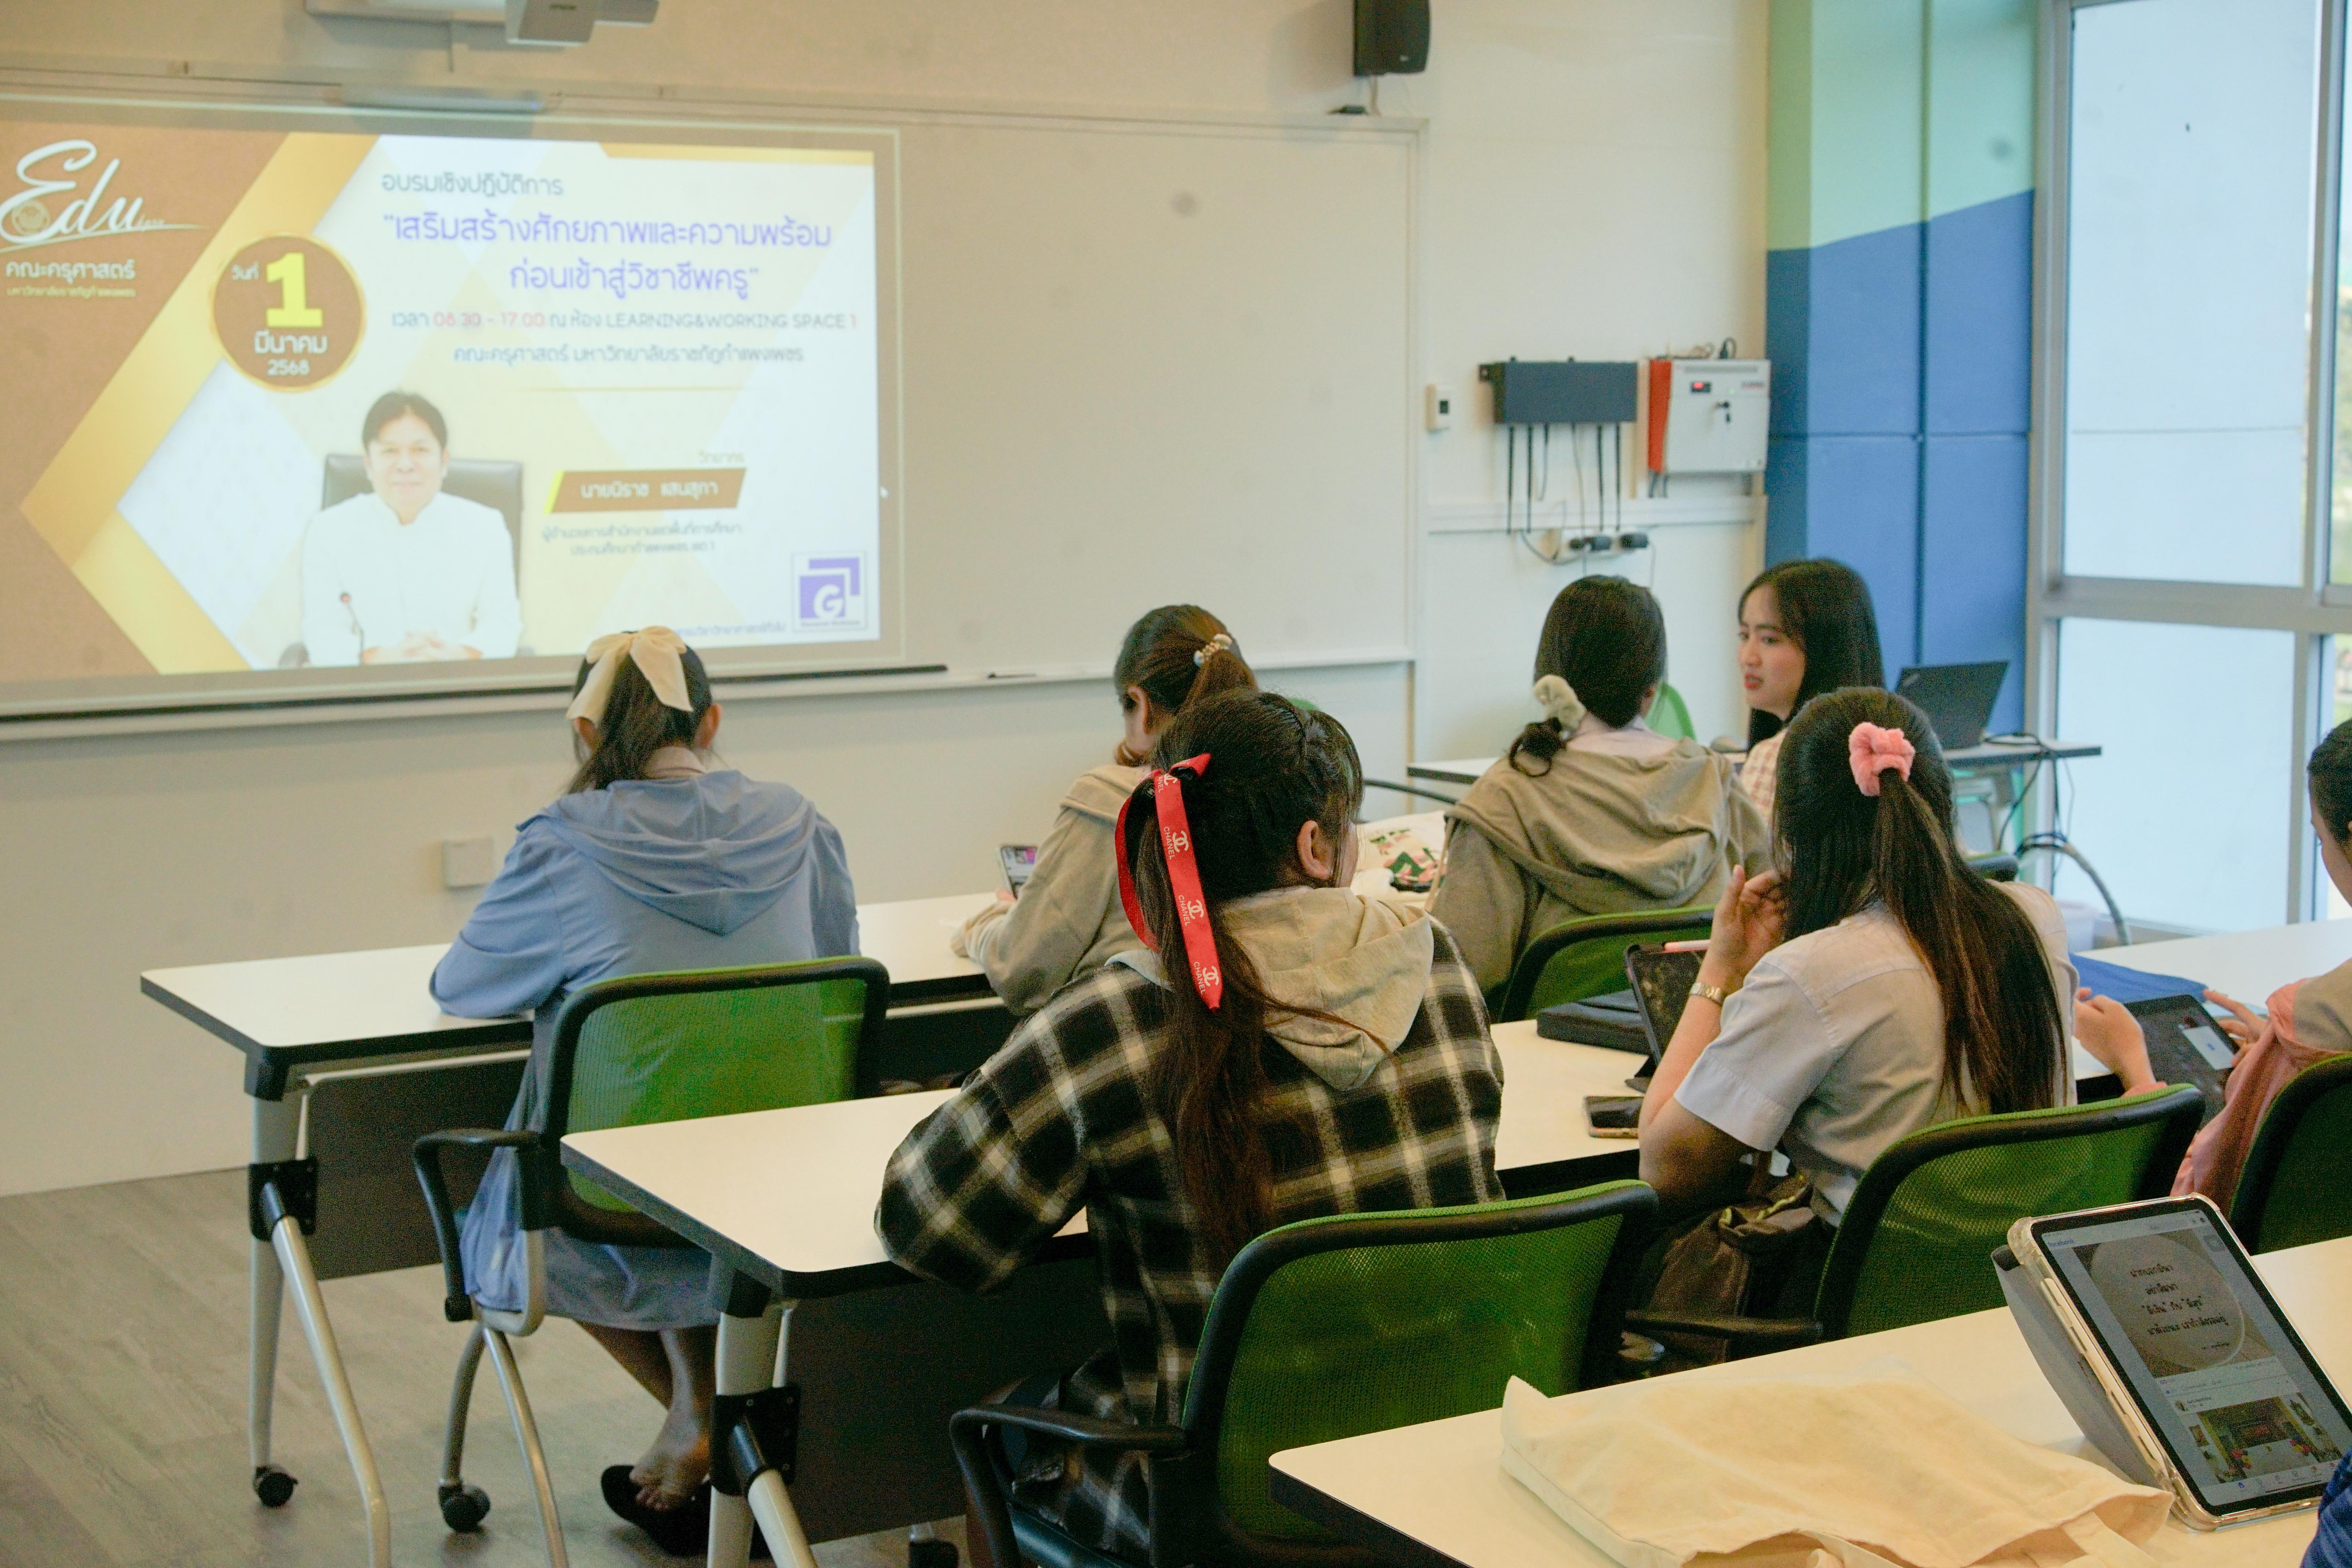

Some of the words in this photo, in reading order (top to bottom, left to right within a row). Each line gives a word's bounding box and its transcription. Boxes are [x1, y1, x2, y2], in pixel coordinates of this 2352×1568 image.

[0, 139, 143, 244] Edu
[382, 171, 564, 197] อบรมเชิงปฏิบัติการ
[5, 258, 136, 285] คณะครุศาสตร์
[232, 261, 260, 281] วันที่
[266, 252, 323, 328] 1
[392, 312, 429, 328] เวลา
[606, 312, 787, 329] LEARNING&WORKING
[792, 313, 845, 329] SPACE
[254, 329, 328, 354] มีนาคม
[453, 343, 570, 367] คณะครุศาสตร์
[267, 359, 311, 376] 2568
[1164, 826, 1176, 860] CHANEL
[1178, 895, 1189, 926] CHANEL
[1193, 961, 1206, 995] CHANEL
